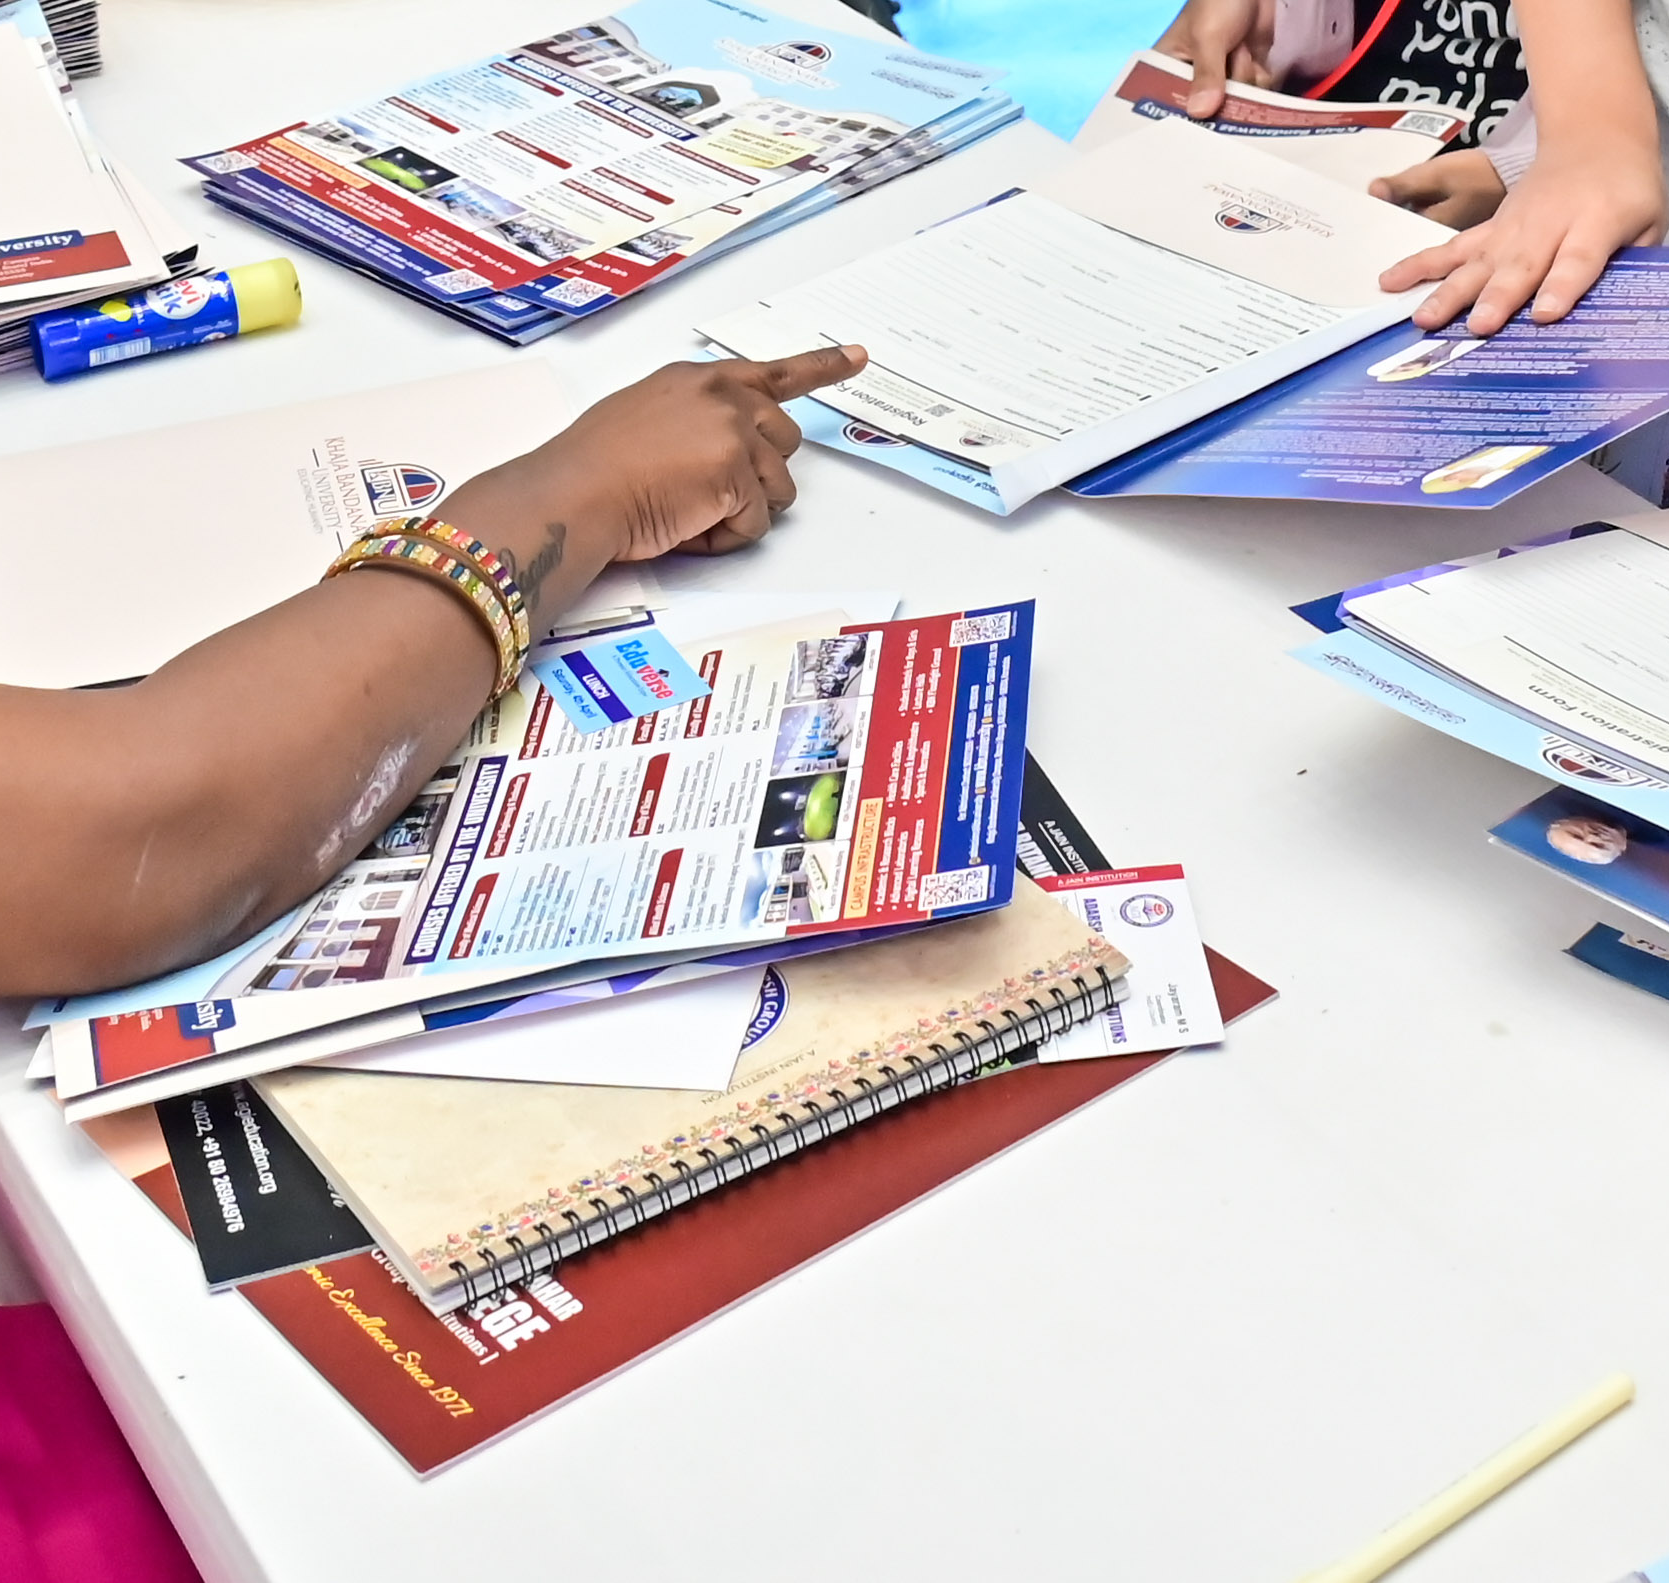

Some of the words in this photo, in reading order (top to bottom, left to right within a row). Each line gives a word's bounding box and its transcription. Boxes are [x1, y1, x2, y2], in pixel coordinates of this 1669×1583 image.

[851, 389, 928, 428] Registration
[324, 436, 352, 473] KHAJA
[582, 672, 612, 702] LUNCH
[614, 638, 676, 702] Eduverse
[1526, 682, 1576, 714] Form
[463, 762, 502, 826] UNIVERSITY
[452, 847, 472, 863] BY
[456, 825, 482, 847] THE
[854, 802, 880, 874] INFRASTRUCTURE
[431, 863, 468, 906] OFFERED
[850, 875, 869, 911] CAMPUS
[410, 906, 451, 959] COURSES
